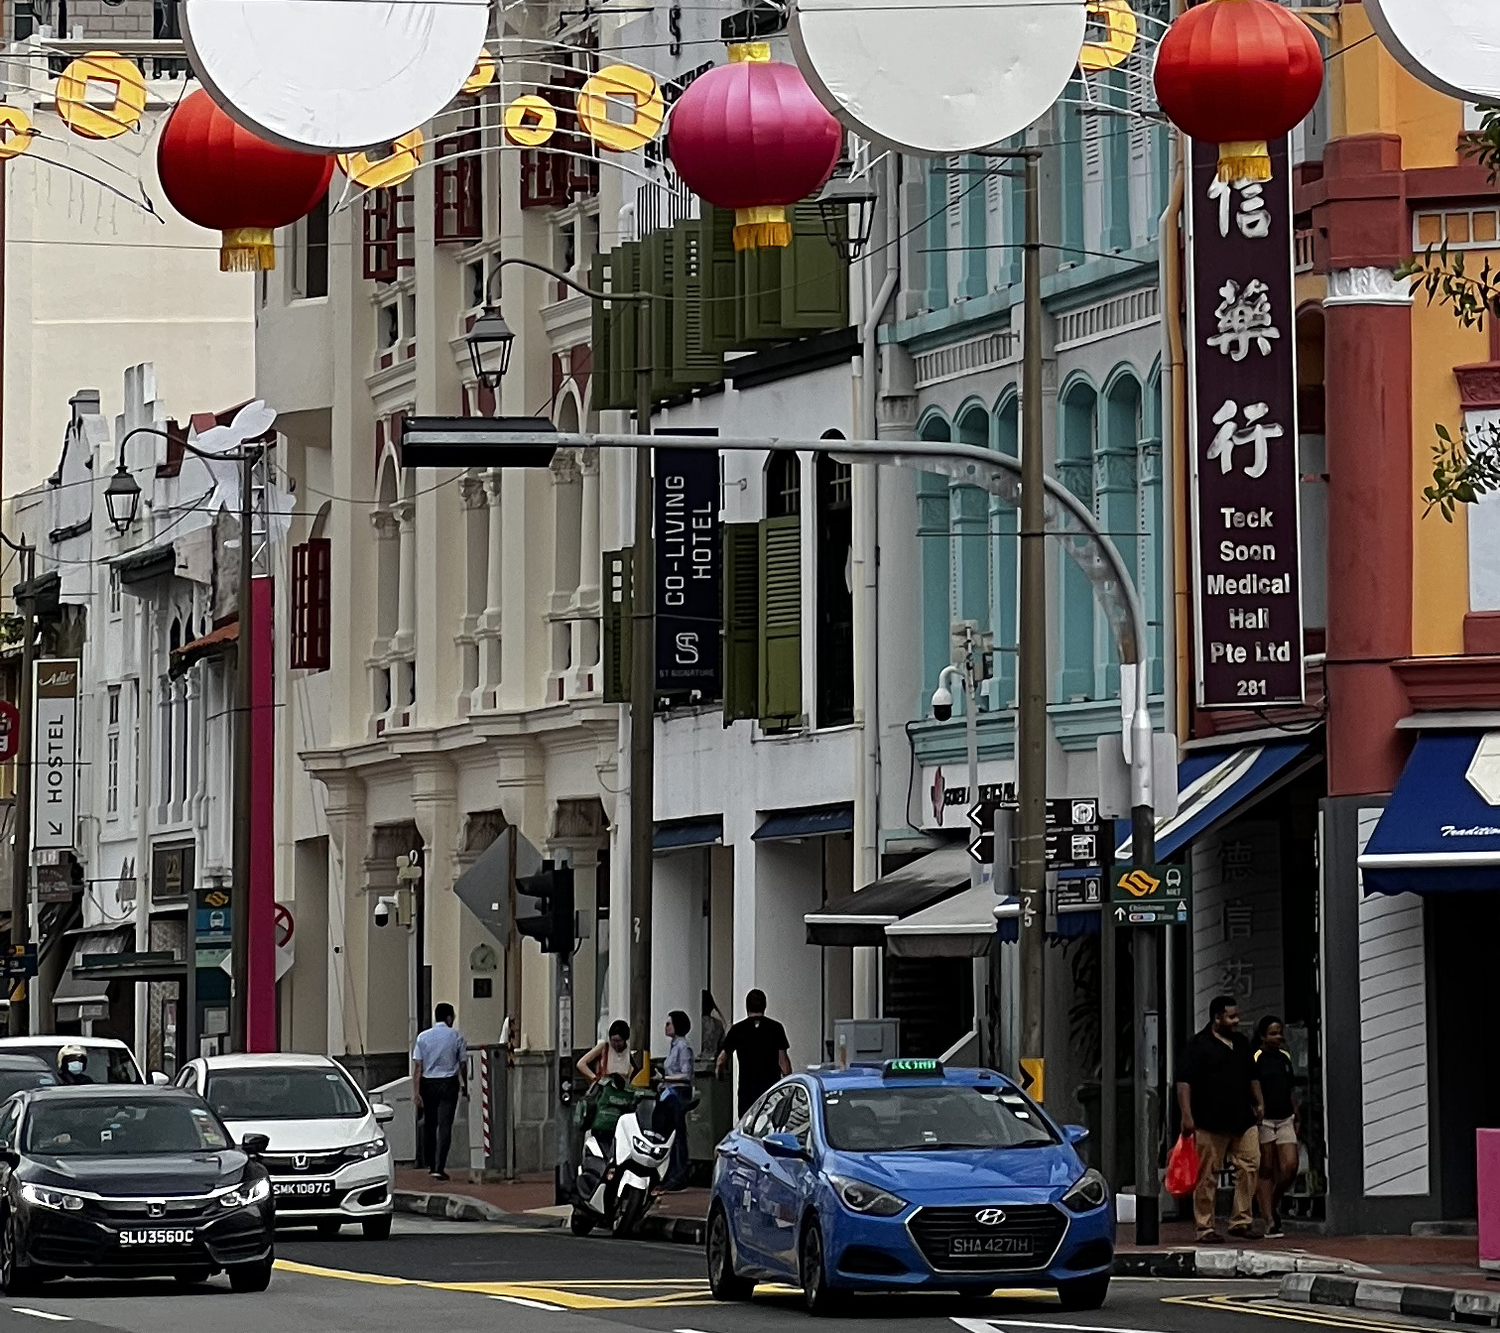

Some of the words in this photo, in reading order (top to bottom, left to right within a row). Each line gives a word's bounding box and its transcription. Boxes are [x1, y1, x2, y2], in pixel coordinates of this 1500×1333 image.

[1220, 507, 1274, 529] Teck
[665, 475, 685, 606] CO-LIVING
[692, 501, 712, 579] HOTEL
[1220, 540, 1276, 563] Soon
[1207, 573, 1290, 596] Medical
[1229, 608, 1270, 630] Hall
[1210, 642, 1247, 665] Pte
[1255, 640, 1291, 664] Ltd
[1237, 679, 1267, 697] 281
[47, 713, 64, 804] HOSTEL
[272, 1182, 331, 1196] SMK1087G
[119, 1229, 194, 1245] SLU3560C
[953, 1238, 982, 1253] SHA
[984, 1237, 1029, 1252] 4271H
